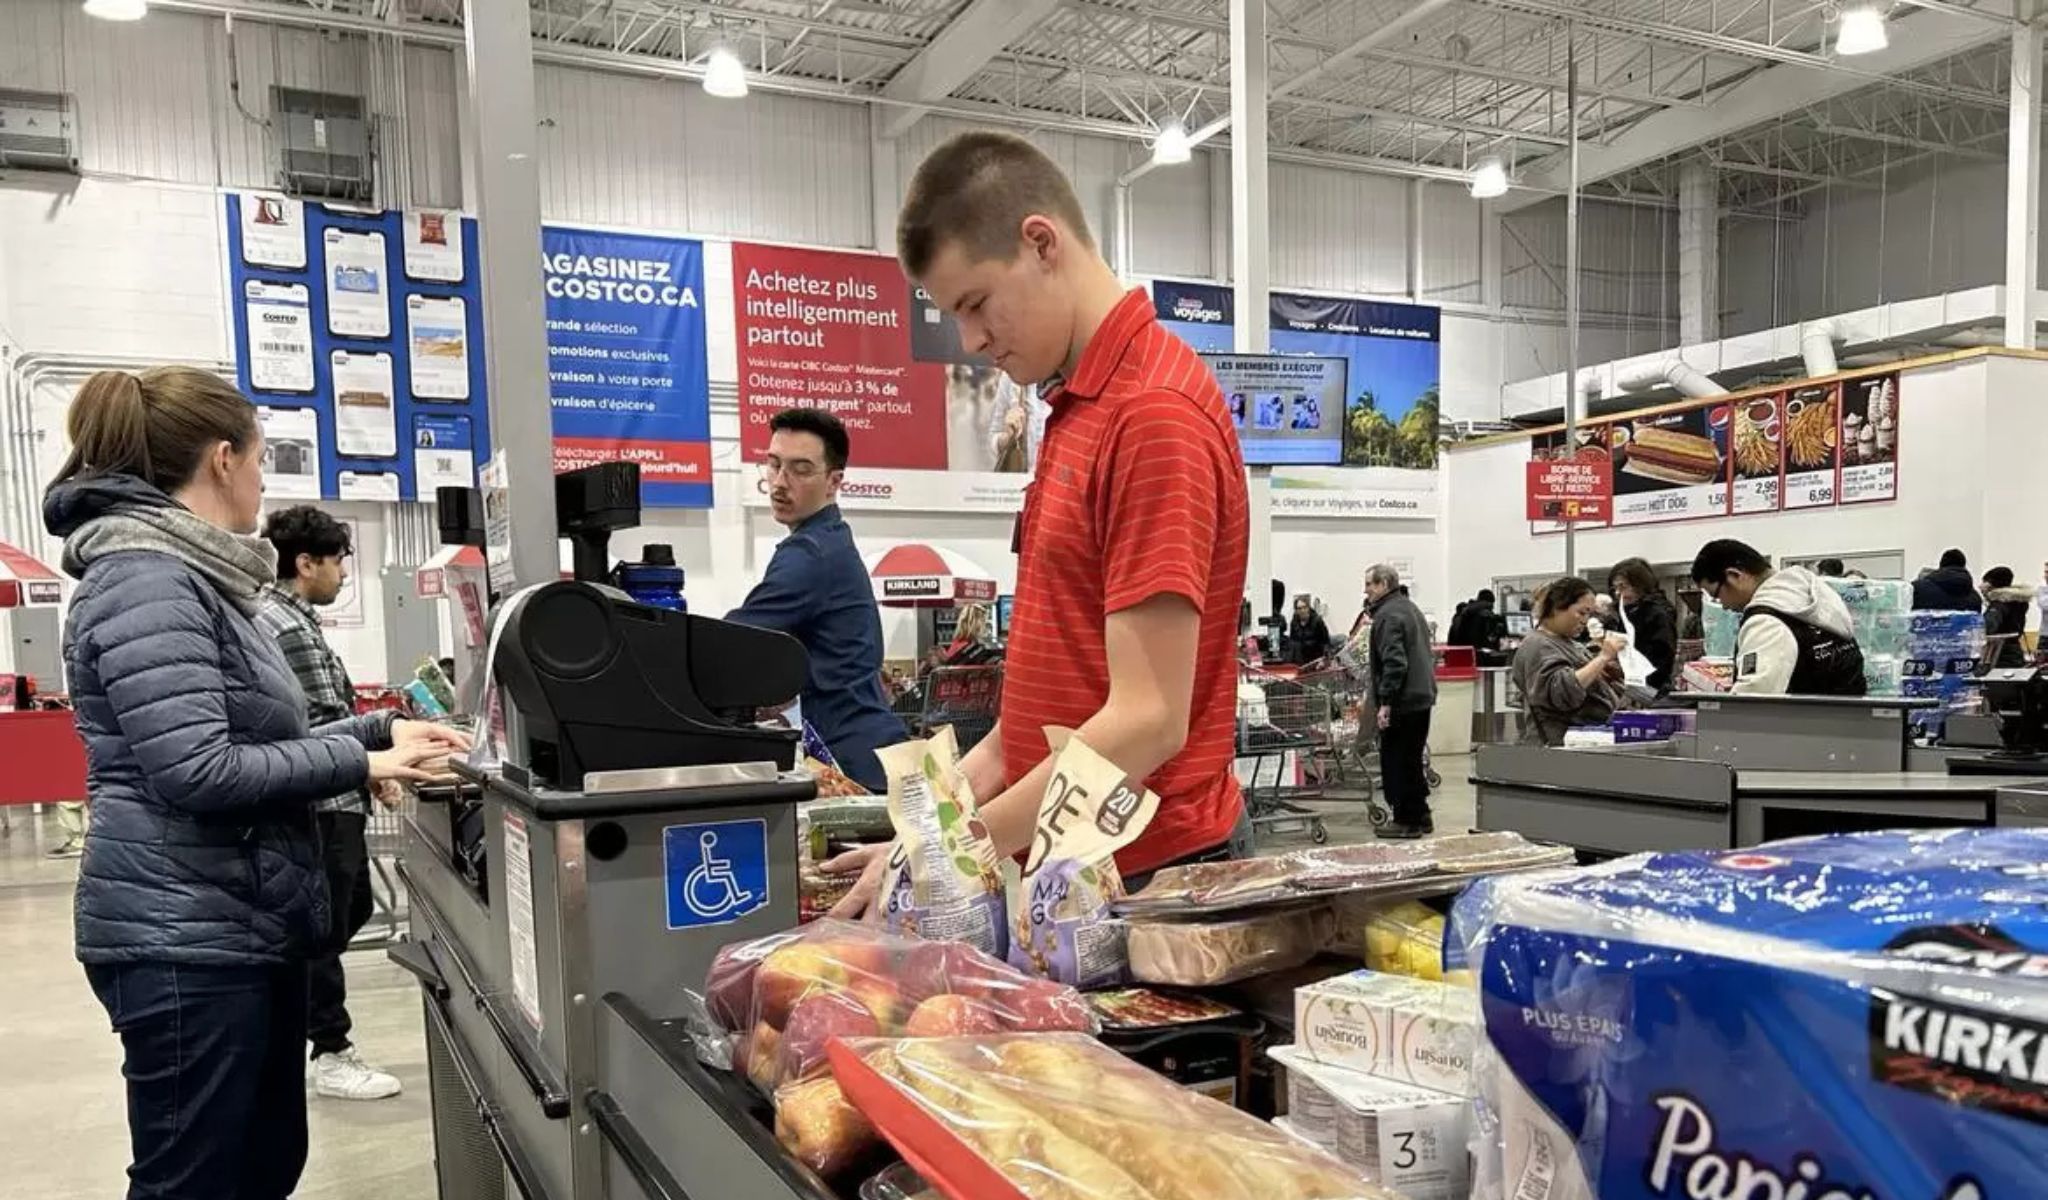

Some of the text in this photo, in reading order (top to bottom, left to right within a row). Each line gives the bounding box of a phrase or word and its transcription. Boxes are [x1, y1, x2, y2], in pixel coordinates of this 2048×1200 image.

[542, 252, 672, 283] AGASINEZ
[546, 277, 698, 308] COSTCO.CA
[746, 267, 878, 301] Achetez plus
[746, 295, 899, 328] intelligemment
[546, 319, 638, 335] rande sélection
[748, 325, 825, 349] partout
[549, 345, 670, 362] omotions exclusives
[550, 370, 594, 384] vraison
[608, 375, 639, 386] votre
[641, 377, 673, 388] porte
[748, 373, 898, 396] Obtenez jusqu'à 3 % de
[551, 396, 656, 412] vraison d'épicerie
[749, 394, 795, 408] remise
[798, 398, 814, 409] en
[867, 401, 912, 415] partout
[750, 408, 767, 423] où
[840, 417, 874, 430] inez.
[554, 446, 617, 460] éléchargez
[1755, 481, 1777, 494] 2,99
[1809, 488, 1832, 502] 6,99
[1648, 499, 1665, 511] HOT
[1667, 496, 1689, 509] DOG
[886, 580, 938, 590] KIRKLAND
[1107, 786, 1138, 815] 20
[1522, 1007, 1572, 1030] PLUS
[1315, 1025, 1368, 1050] Boursin
[1415, 1046, 1469, 1071] oursin
[1393, 1131, 1416, 1169] 3
